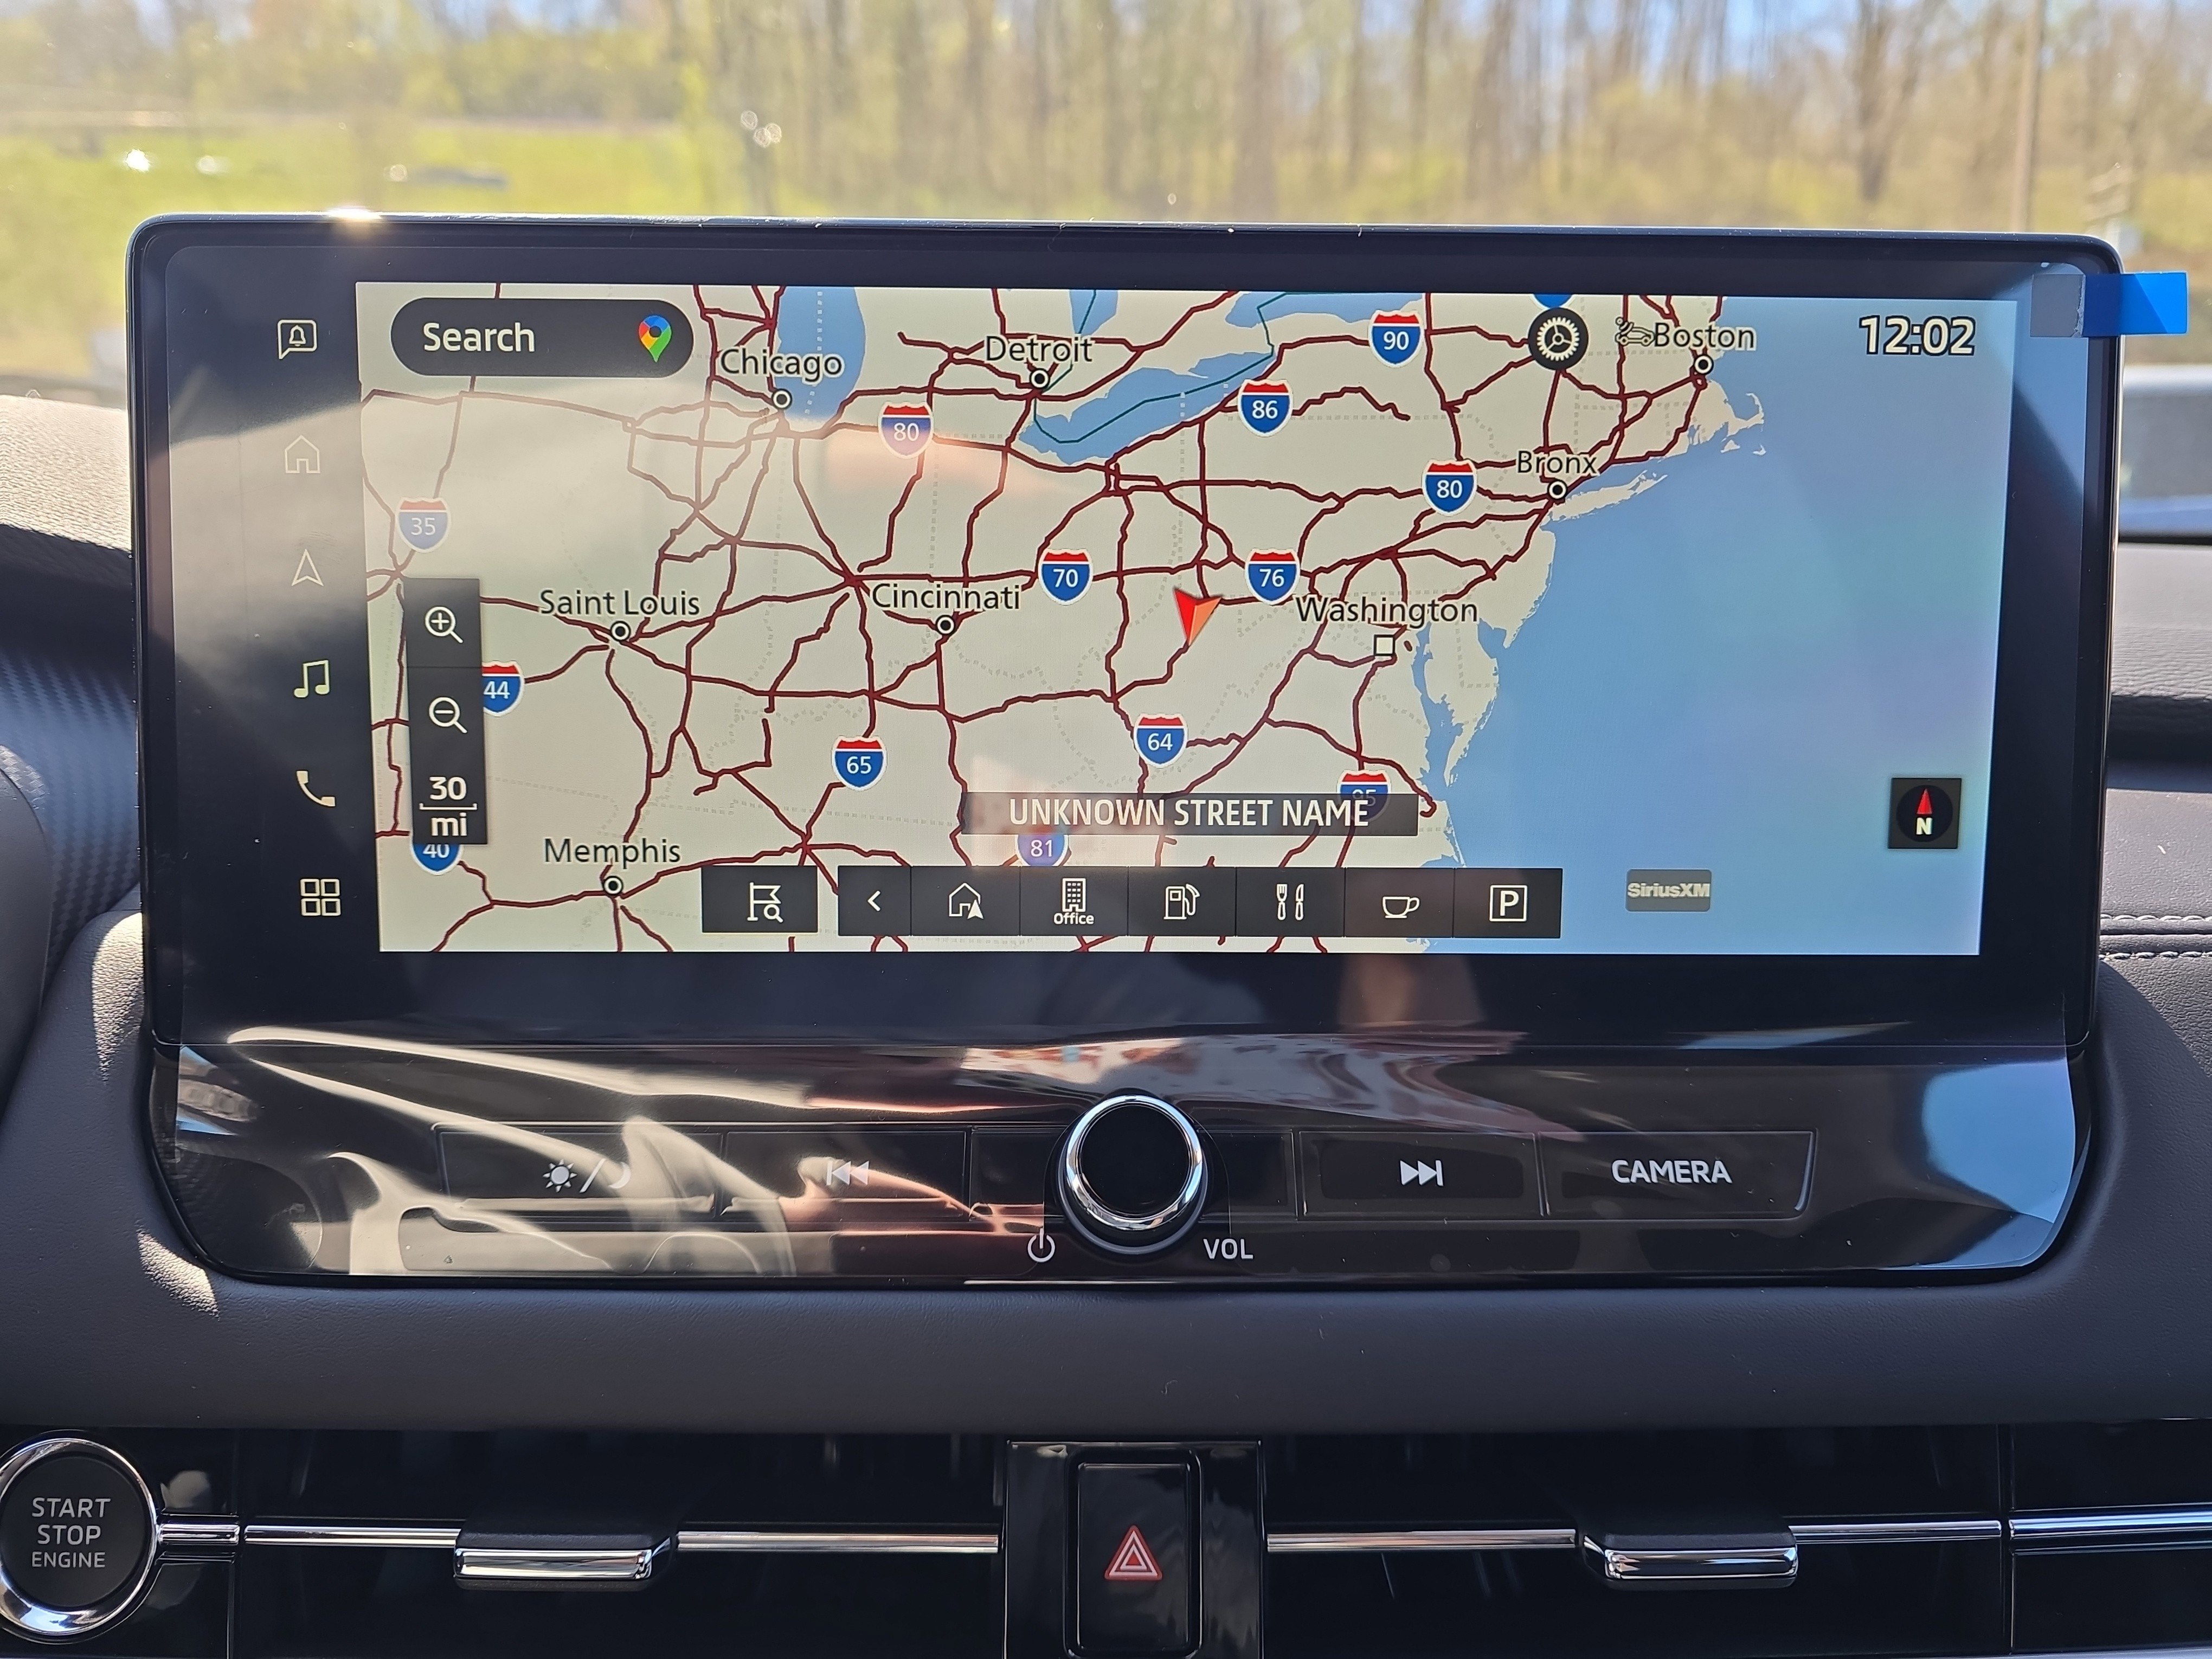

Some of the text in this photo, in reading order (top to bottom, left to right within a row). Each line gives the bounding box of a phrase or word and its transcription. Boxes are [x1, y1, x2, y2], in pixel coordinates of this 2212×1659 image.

[423, 322, 536, 353] Search
[1383, 331, 1409, 350] 90
[1654, 322, 1756, 349] Boston
[1860, 315, 1976, 356] 12:02
[986, 336, 1093, 363] Detroit
[720, 349, 843, 382] Chicago
[1252, 400, 1278, 420] 86
[893, 422, 919, 442] 80
[1517, 451, 1597, 474] Bronx
[1436, 479, 1463, 499] 80
[410, 517, 436, 536] 35
[1053, 568, 1078, 588] 70
[1259, 568, 1284, 588] 76
[540, 590, 700, 616] Saint Louis
[872, 583, 1021, 609] Cincinnati
[1296, 595, 1478, 629] Washington
[483, 680, 510, 699] 44
[1147, 732, 1173, 752] 64
[846, 755, 872, 774] 65
[429, 776, 467, 800] 30
[1009, 799, 1369, 826] UNKNOWN STREET NAME
[431, 813, 467, 837] mi
[1915, 817, 1932, 835] N
[423, 844, 451, 859] 40
[545, 838, 680, 869] Memphis
[1030, 839, 1054, 857] 81
[1627, 882, 1711, 899] SiriusXM
[1499, 890, 1519, 917] P
[1053, 911, 1095, 925] Office
[1611, 1160, 1732, 1184] CAMERA
[1203, 1238, 1253, 1261] VOL
[31, 1497, 111, 1518] START
[37, 1525, 101, 1545] STOP
[31, 1552, 106, 1568] ENGINE
